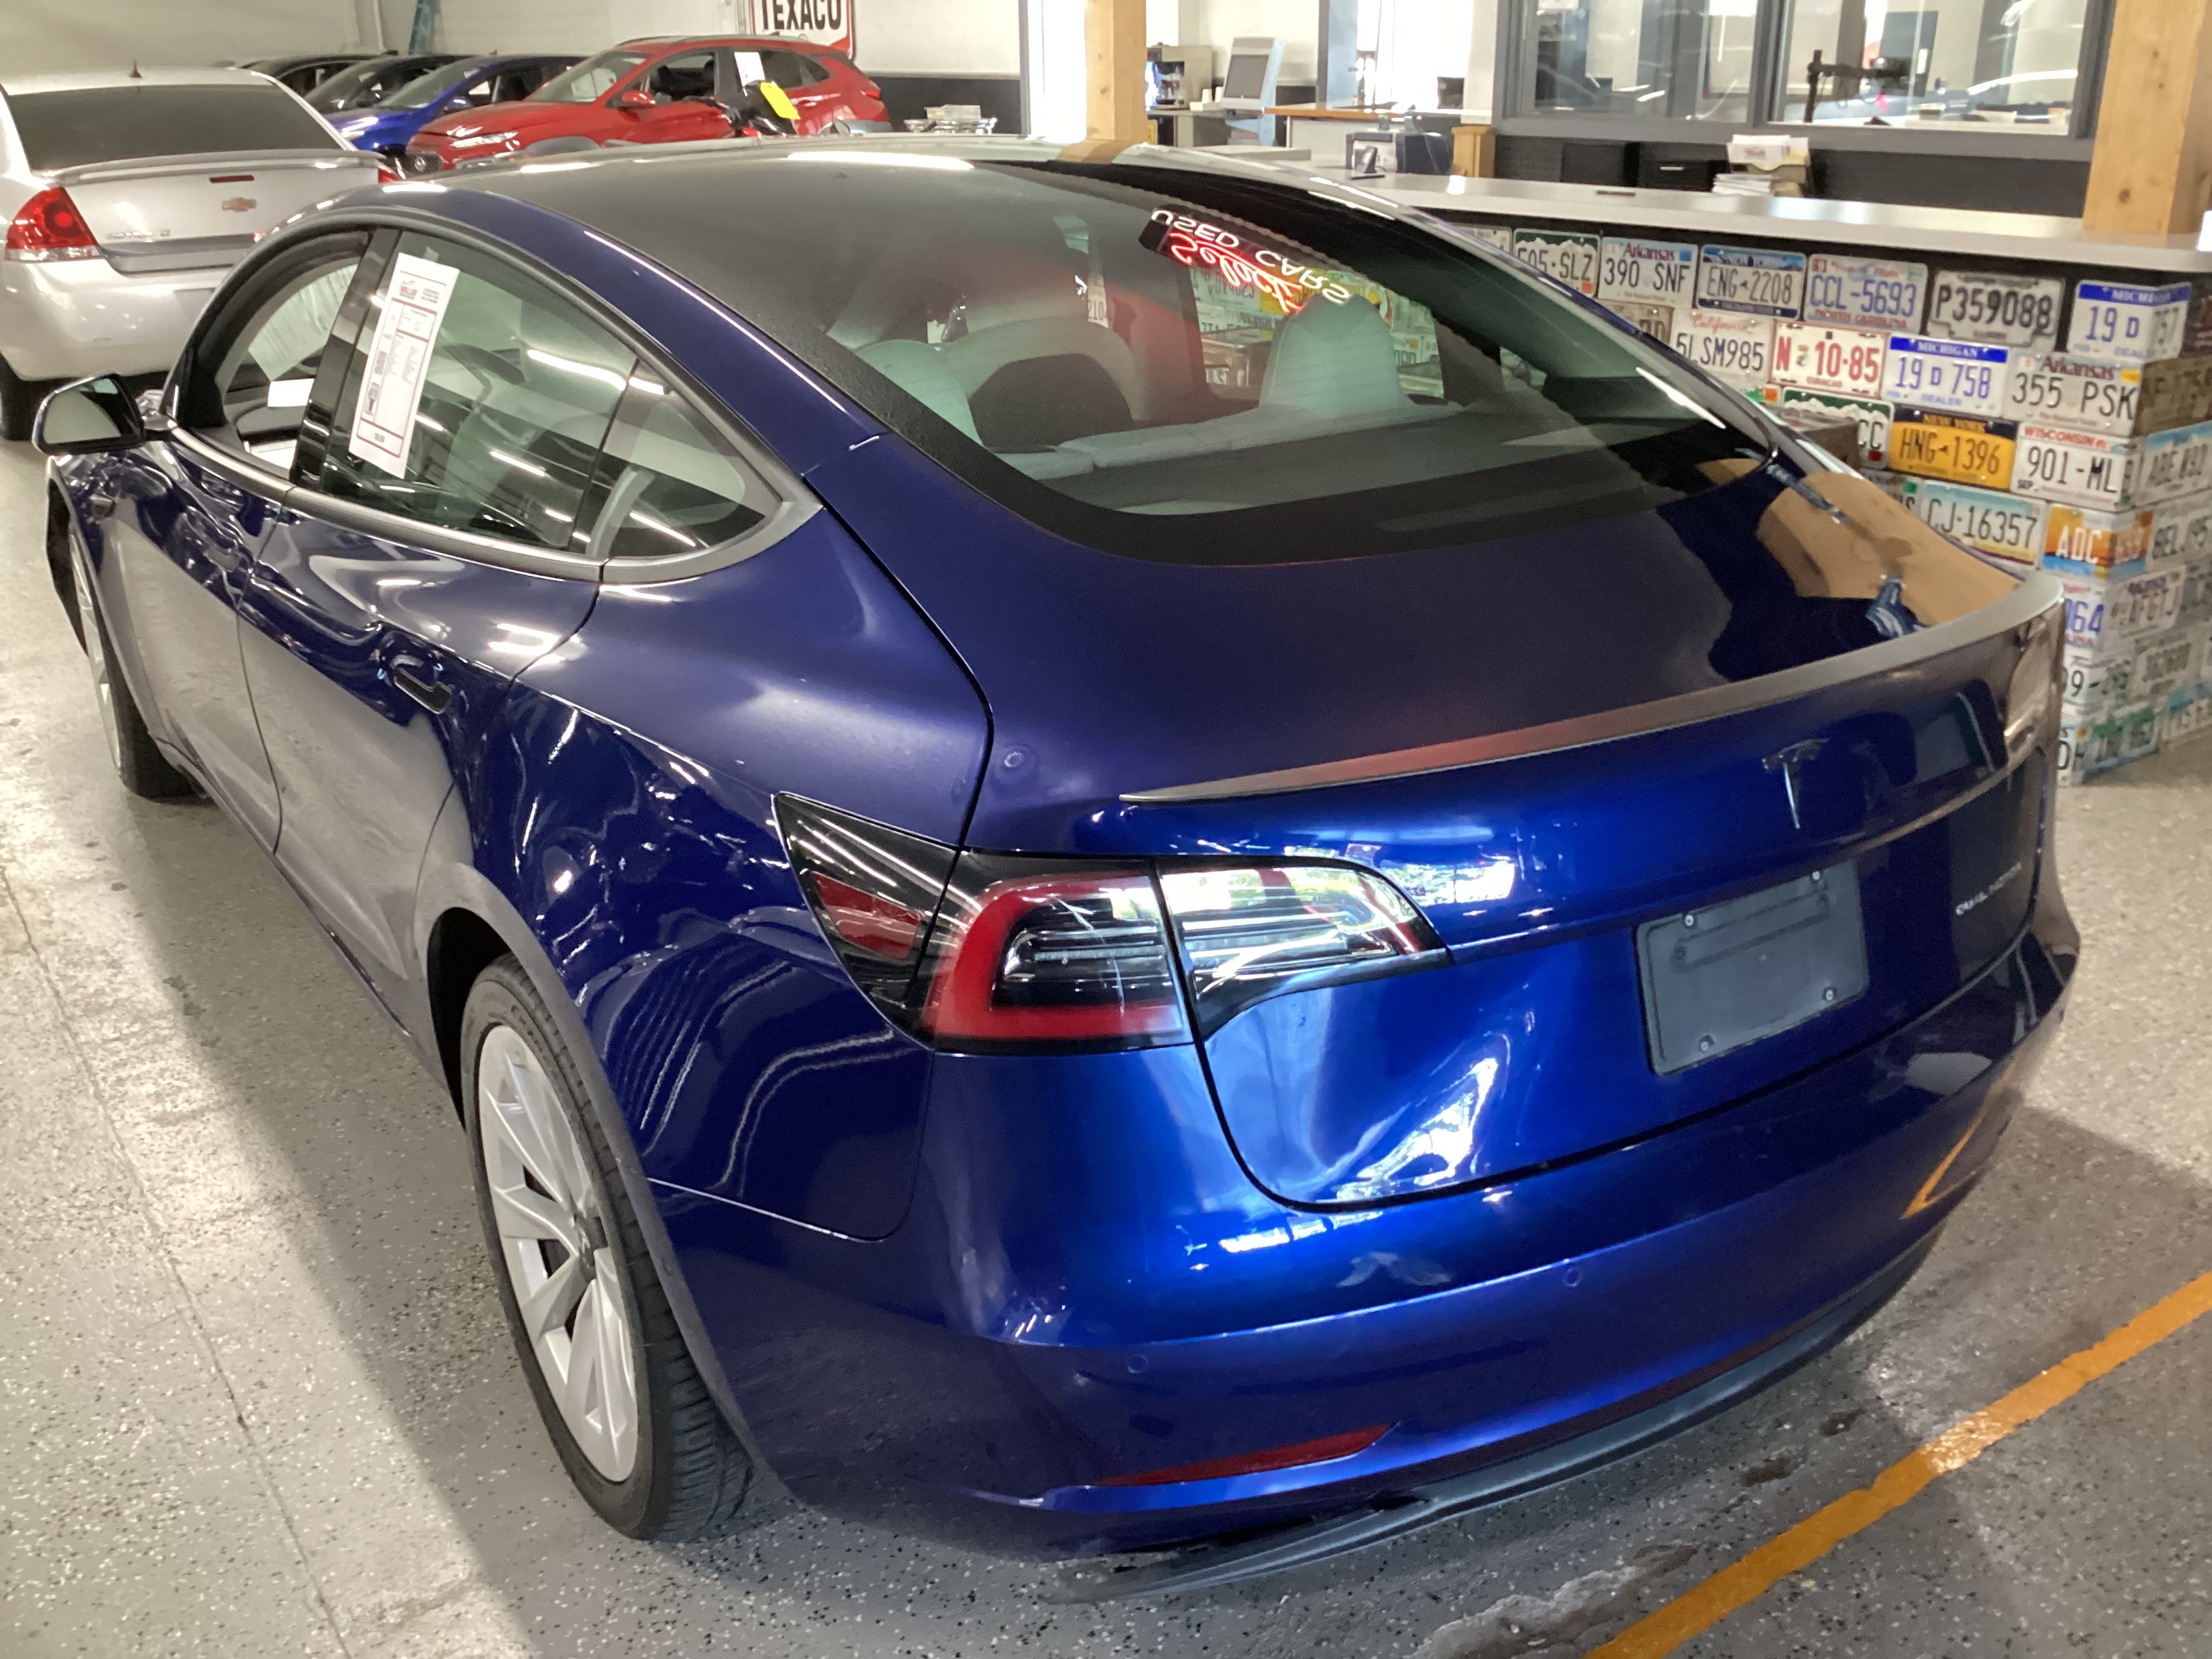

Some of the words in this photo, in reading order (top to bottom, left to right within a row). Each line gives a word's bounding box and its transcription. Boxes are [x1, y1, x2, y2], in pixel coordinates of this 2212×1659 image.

[1624, 243, 1675, 261] Arkansas
[1604, 258, 1640, 288] 390
[1653, 263, 1691, 293] SNF
[1810, 274, 1917, 317] CCL-5693
[1936, 285, 2053, 329] P359088
[2085, 306, 2118, 342] 19
[1917, 342, 1978, 357] MICHIGAN
[1896, 356, 1923, 390] 19
[1952, 363, 1992, 399] 758
[2041, 356, 2115, 381] Arkansas
[2012, 372, 2064, 409] 355
[2081, 381, 2137, 420] PSK
[2024, 426, 2095, 447] WISCONSIN
